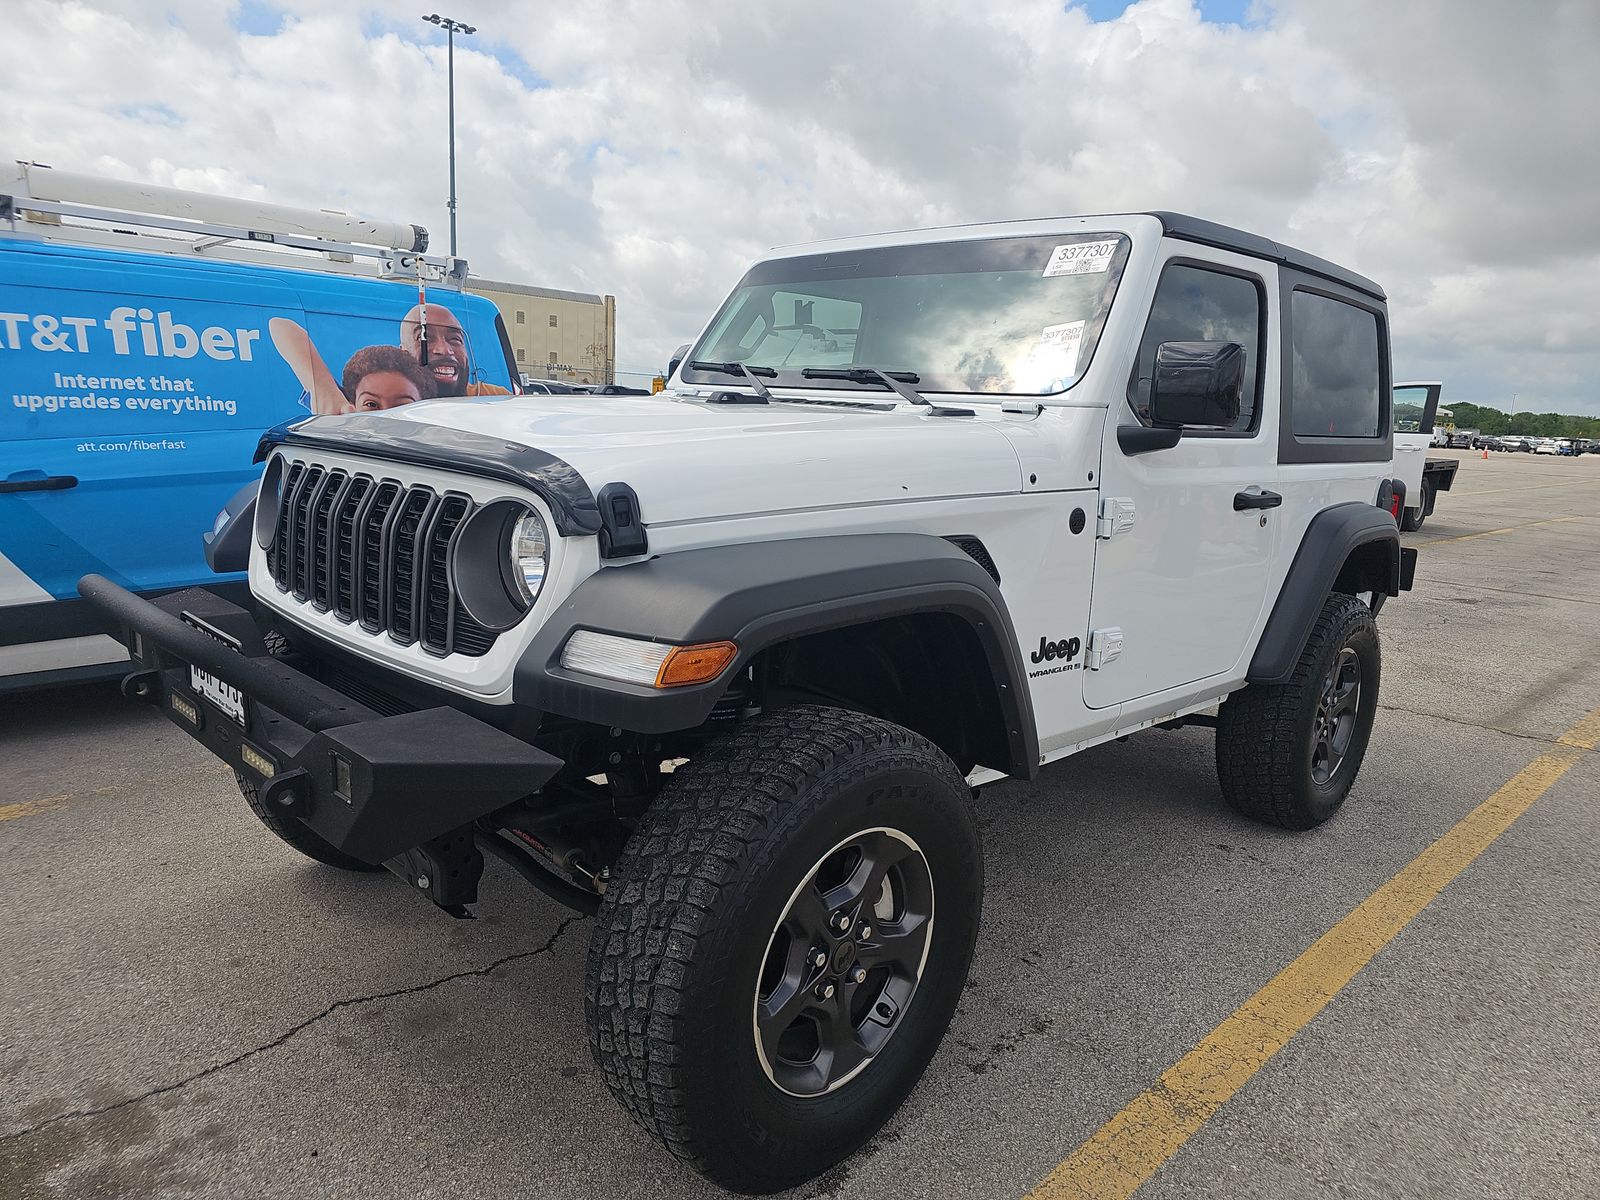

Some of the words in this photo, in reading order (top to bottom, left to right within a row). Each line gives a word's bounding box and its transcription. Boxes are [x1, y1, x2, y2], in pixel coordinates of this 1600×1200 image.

[1058, 244, 1117, 260] 3377307
[0, 312, 97, 353] T&T
[104, 306, 260, 362] fiber
[54, 372, 146, 391] Internet
[150, 376, 195, 392] that
[13, 393, 121, 415] upgrades
[125, 396, 237, 415] everything
[77, 440, 186, 453] att.com/fiberfast
[1030, 636, 1081, 664] Jeep
[1029, 665, 1073, 678] WRANGLER
